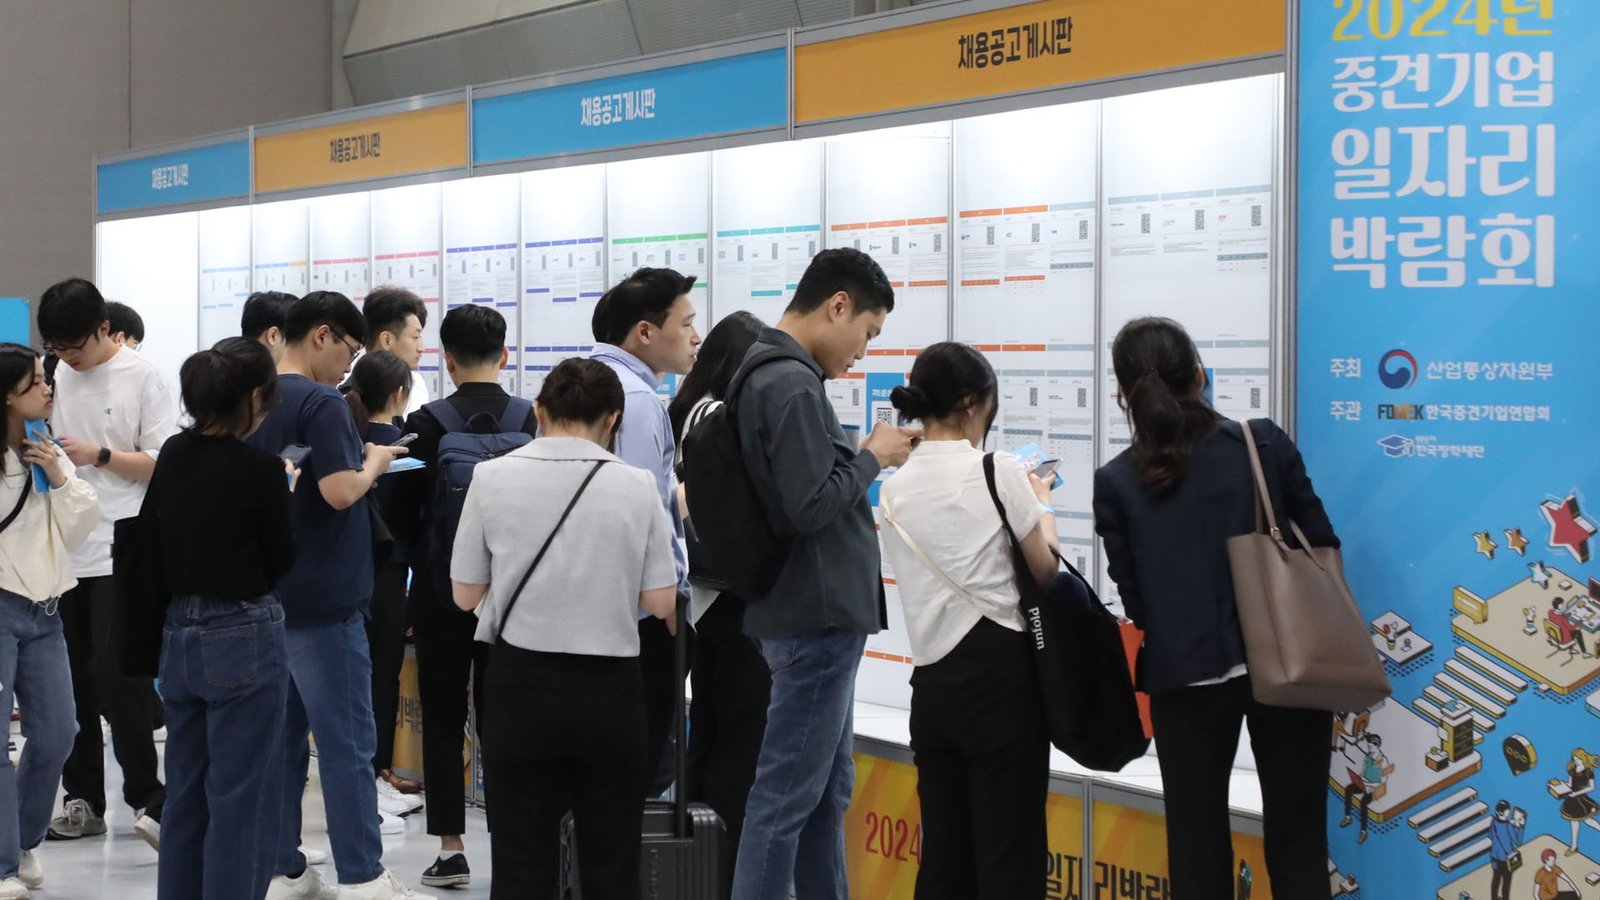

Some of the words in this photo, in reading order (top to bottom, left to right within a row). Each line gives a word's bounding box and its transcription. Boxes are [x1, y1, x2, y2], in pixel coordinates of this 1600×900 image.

[958, 16, 1073, 69] 채용공고게시판
[1332, 51, 1554, 112] 중견기업
[580, 87, 656, 127] 채용공고게시판
[330, 132, 381, 163] 채용공고게시판
[1331, 123, 1556, 200] 일자리
[151, 164, 189, 189] 채용공고게시판
[1330, 213, 1555, 289] 박람회
[1330, 358, 1361, 378] 주최
[1426, 361, 1554, 381] 산업통상자원부
[1330, 401, 1361, 421] 주관
[1377, 404, 1424, 420] FOMEK
[1425, 404, 1551, 422] 한국중견기업연합회
[1028, 606, 1045, 650] unfold
[866, 811, 920, 865] 2024
